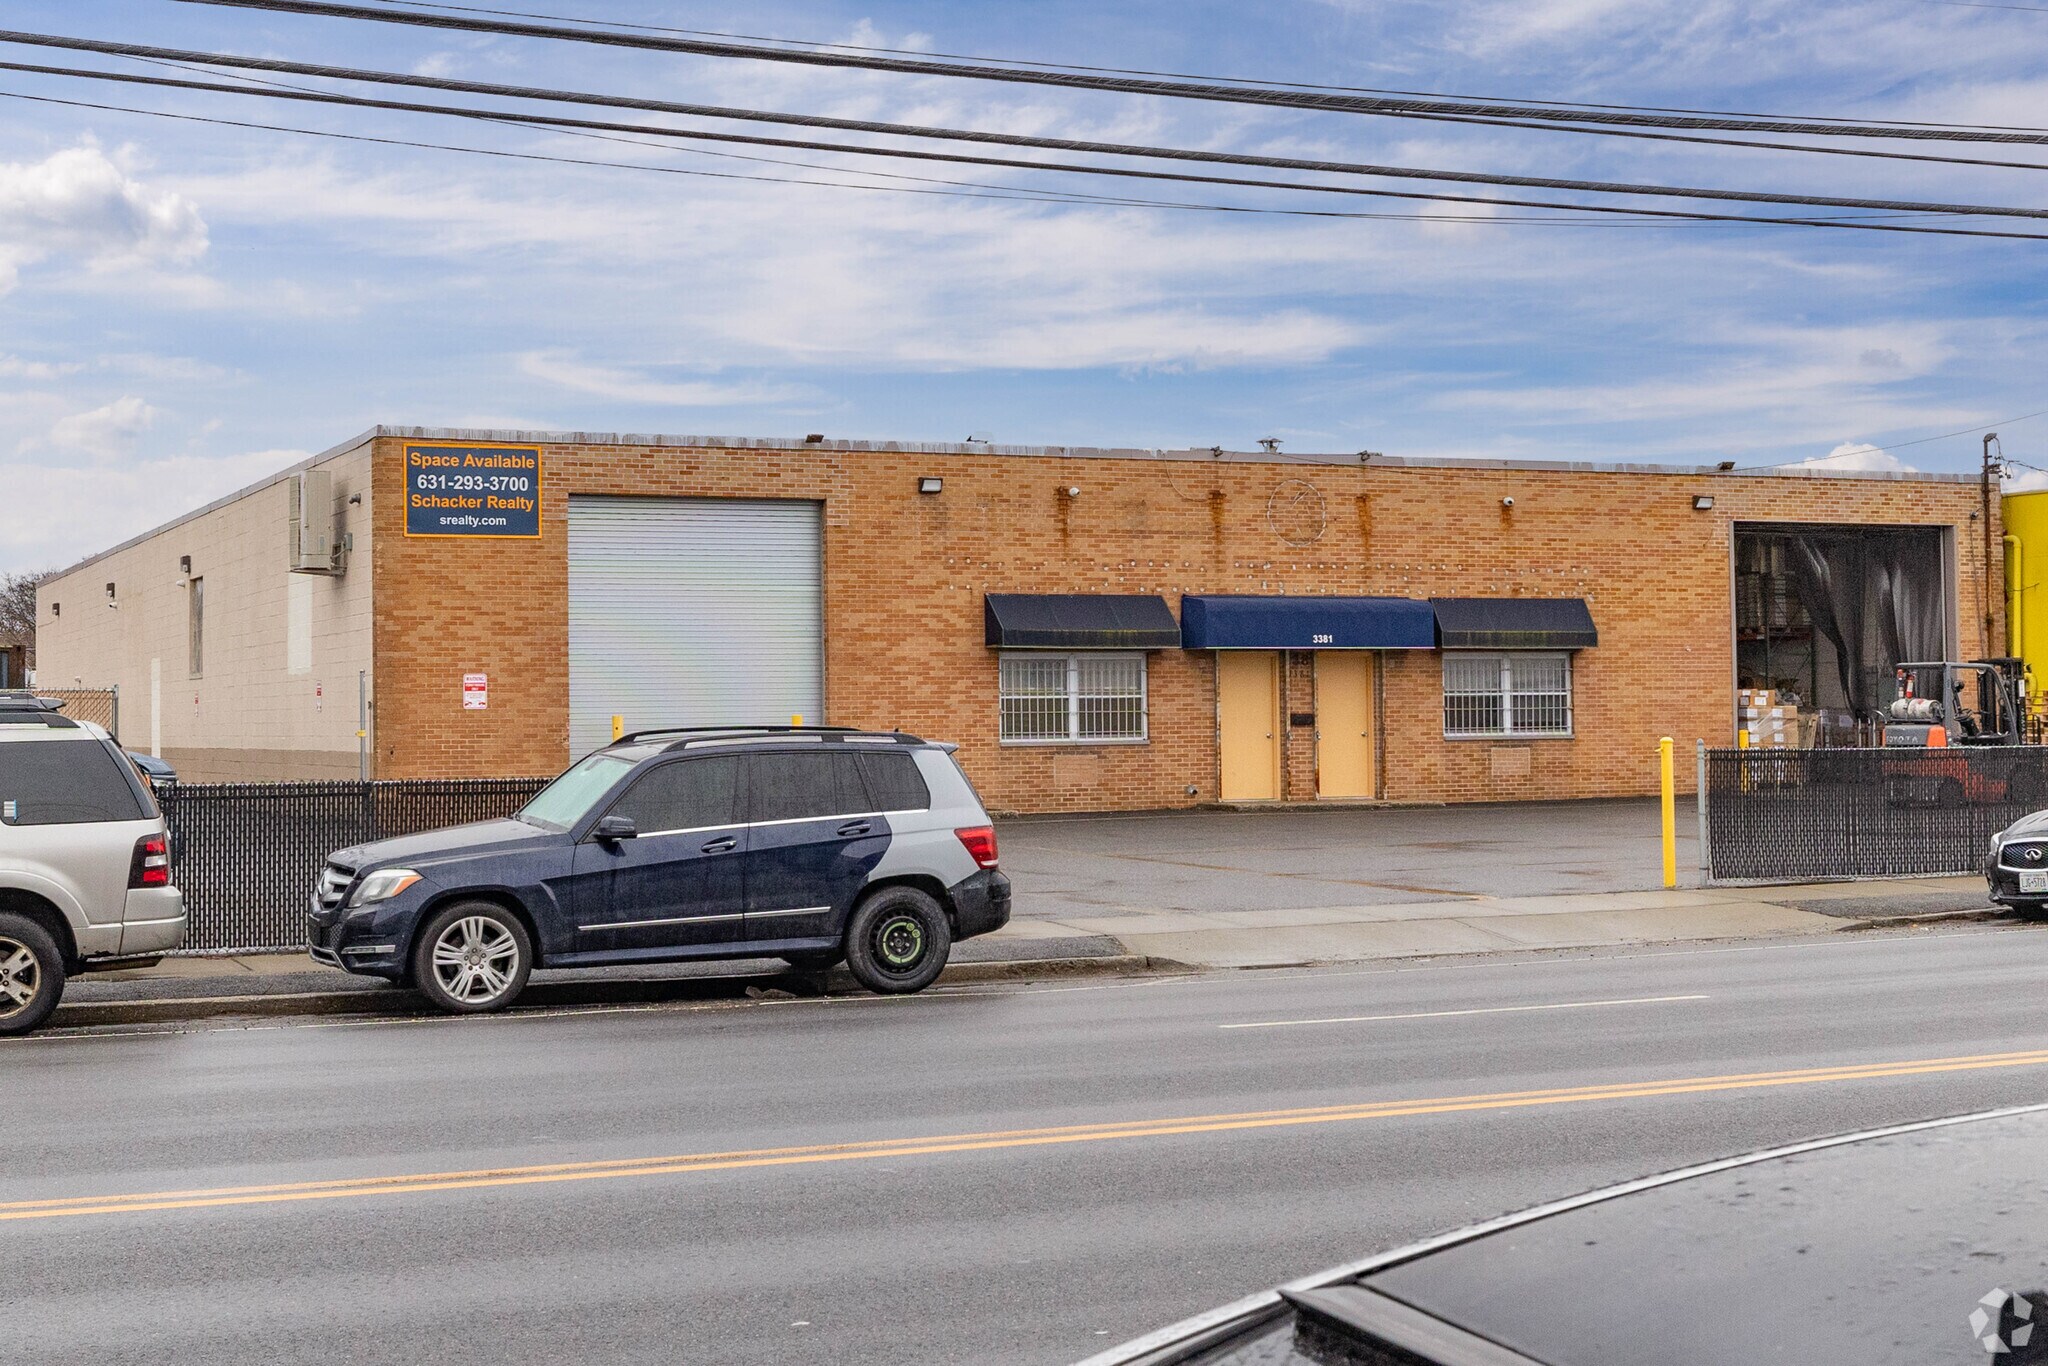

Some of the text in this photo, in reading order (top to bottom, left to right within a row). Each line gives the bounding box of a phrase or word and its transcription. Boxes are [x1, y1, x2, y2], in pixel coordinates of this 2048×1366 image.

[410, 452, 535, 469] Space Available
[417, 474, 529, 491] 631-293-3700
[411, 494, 534, 512] Schacker Realty
[439, 515, 507, 527] srealty.com
[1312, 634, 1333, 643] 3381
